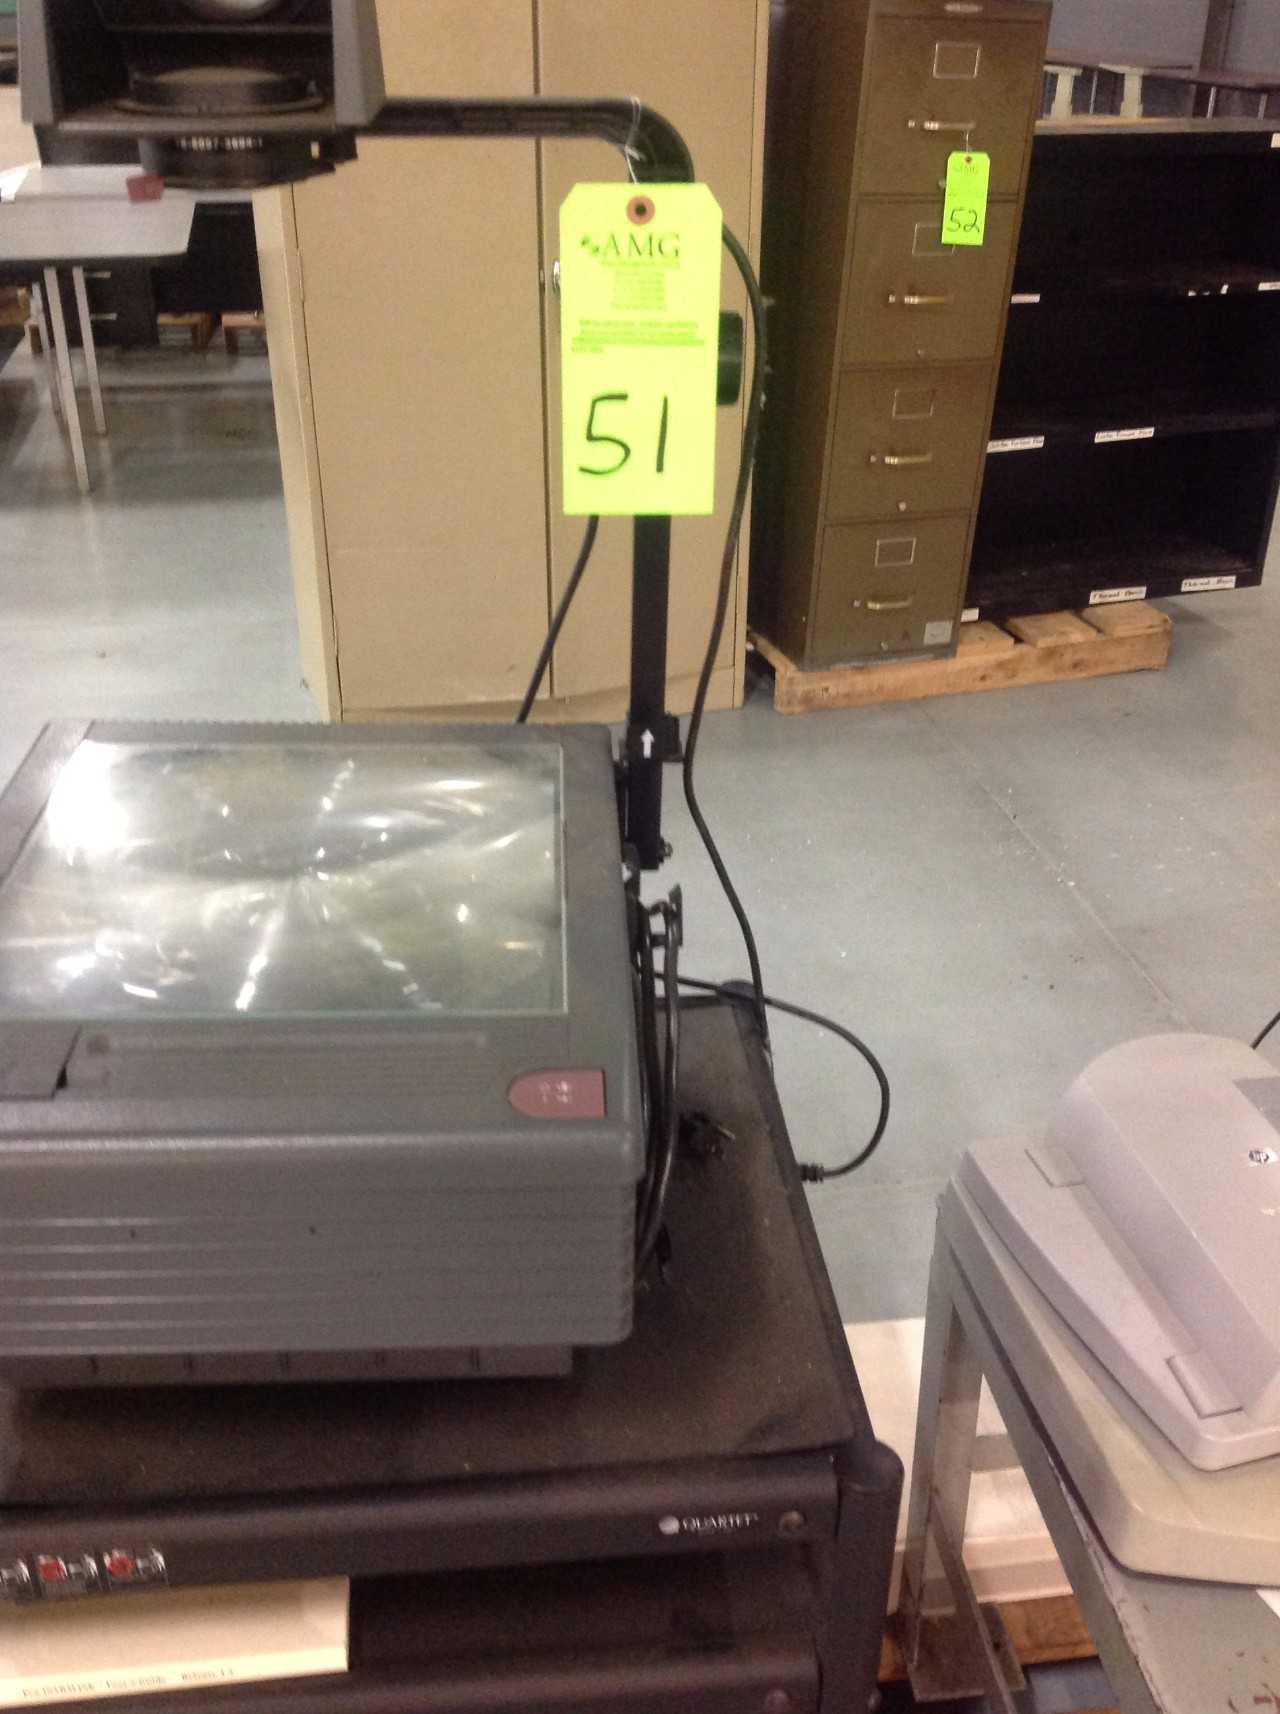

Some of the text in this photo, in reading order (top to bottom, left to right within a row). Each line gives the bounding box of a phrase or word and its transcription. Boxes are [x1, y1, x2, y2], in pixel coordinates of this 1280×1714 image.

[946, 206, 980, 234] 52
[602, 231, 681, 258] AMG
[578, 393, 669, 476] 51
